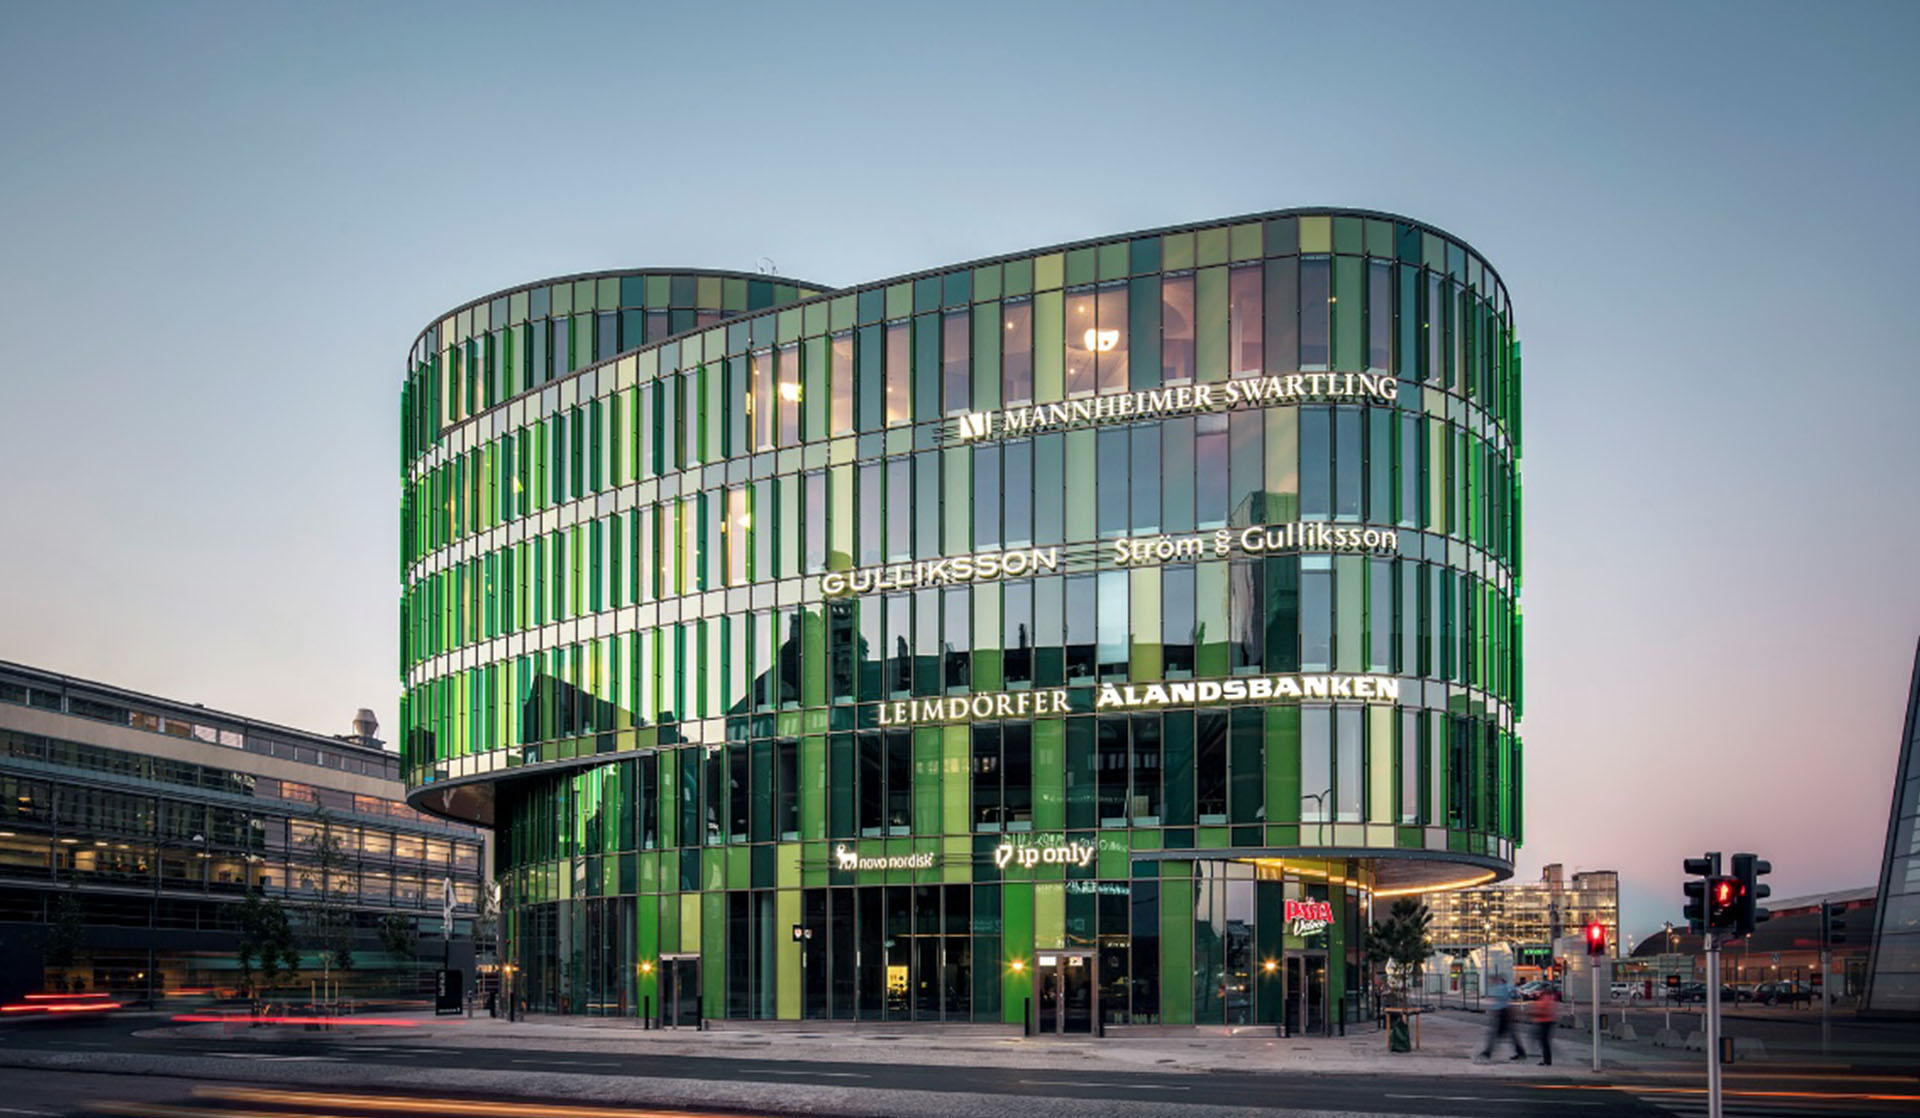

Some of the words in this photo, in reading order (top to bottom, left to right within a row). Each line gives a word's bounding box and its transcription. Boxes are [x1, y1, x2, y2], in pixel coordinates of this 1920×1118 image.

[1003, 384, 1214, 432] MANNHEIMER
[1225, 373, 1398, 403] SWARTLING
[1114, 534, 1203, 565] Ström
[1241, 522, 1398, 551] Gulliksson
[822, 547, 1058, 595] GULLIKSSON
[878, 690, 1073, 725] LEIMDÖRFER
[1097, 675, 1399, 708] ÅLANDSBANKEN
[859, 857, 887, 869] novo
[888, 852, 932, 869] nordisk
[1016, 843, 1040, 868] ip
[1043, 841, 1094, 867] only
